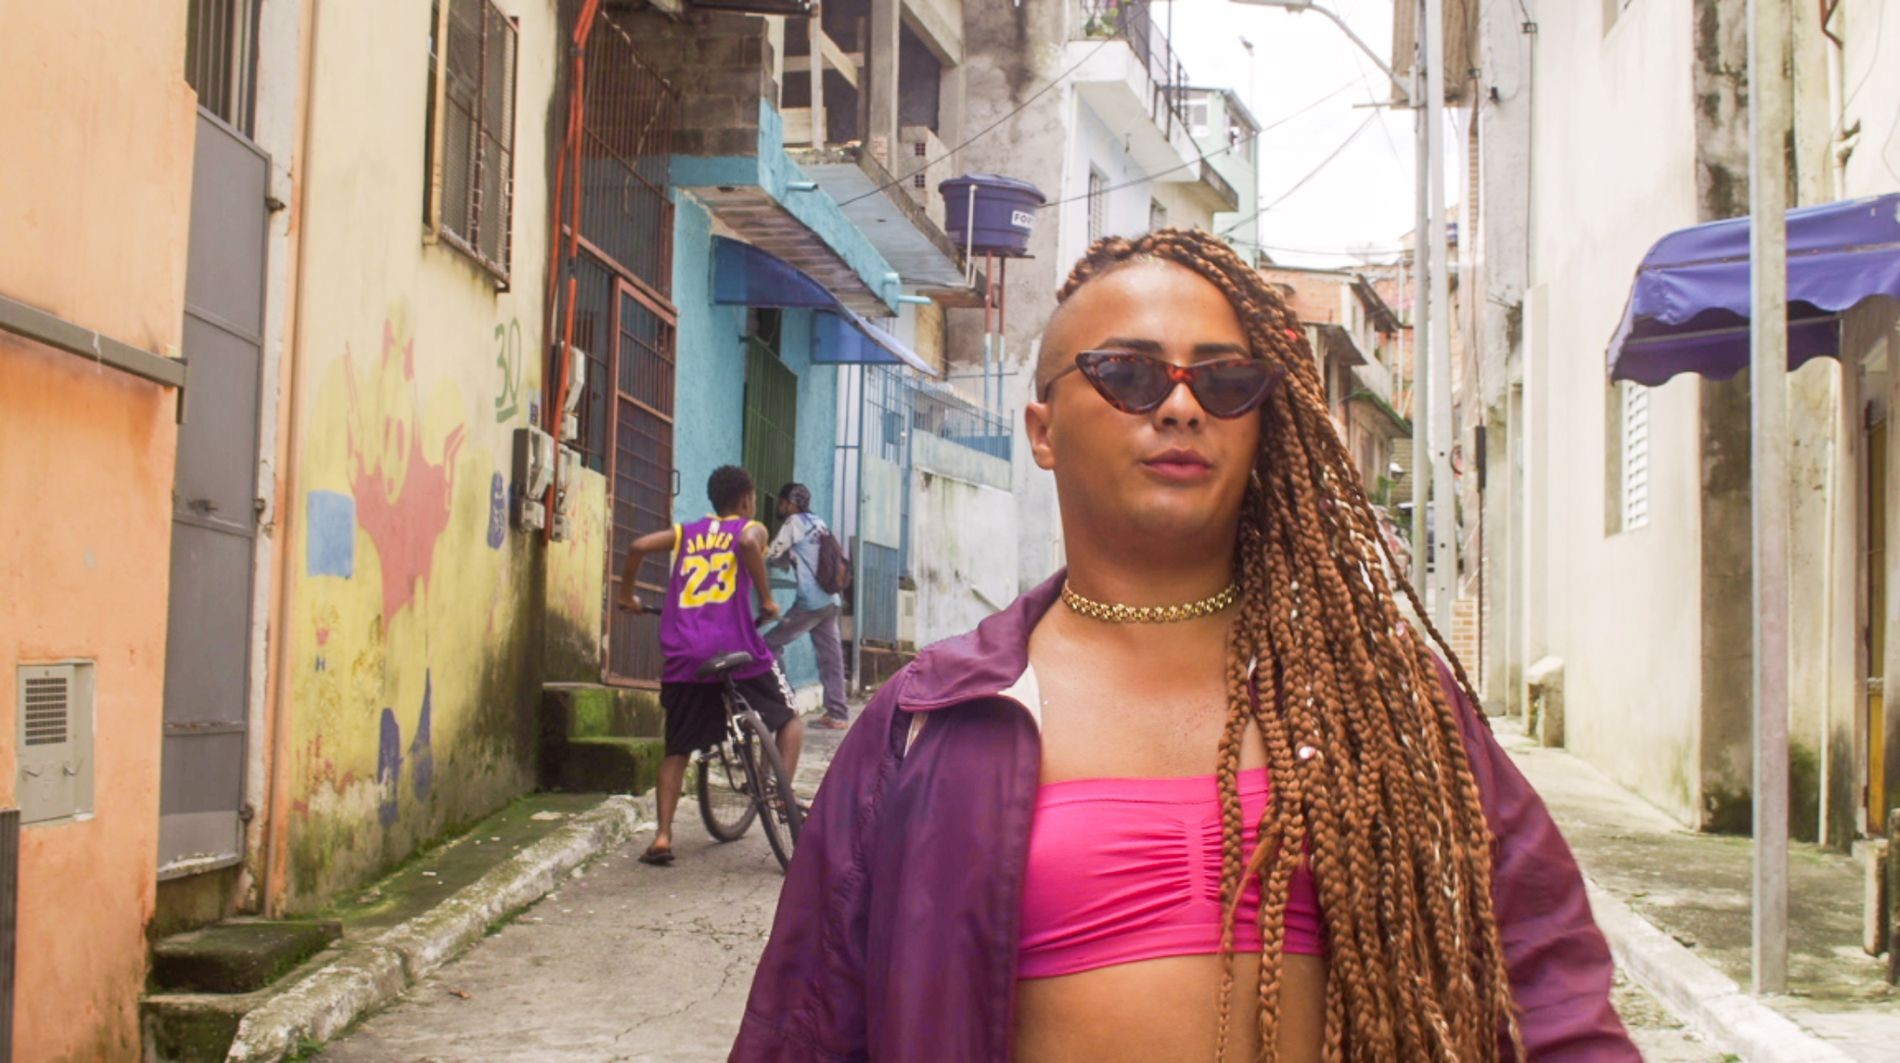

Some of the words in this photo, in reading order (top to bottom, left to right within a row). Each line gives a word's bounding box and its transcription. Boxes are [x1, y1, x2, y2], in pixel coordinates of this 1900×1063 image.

[494, 317, 521, 409] 30
[686, 532, 734, 554] JAMES
[678, 550, 738, 608] 23
